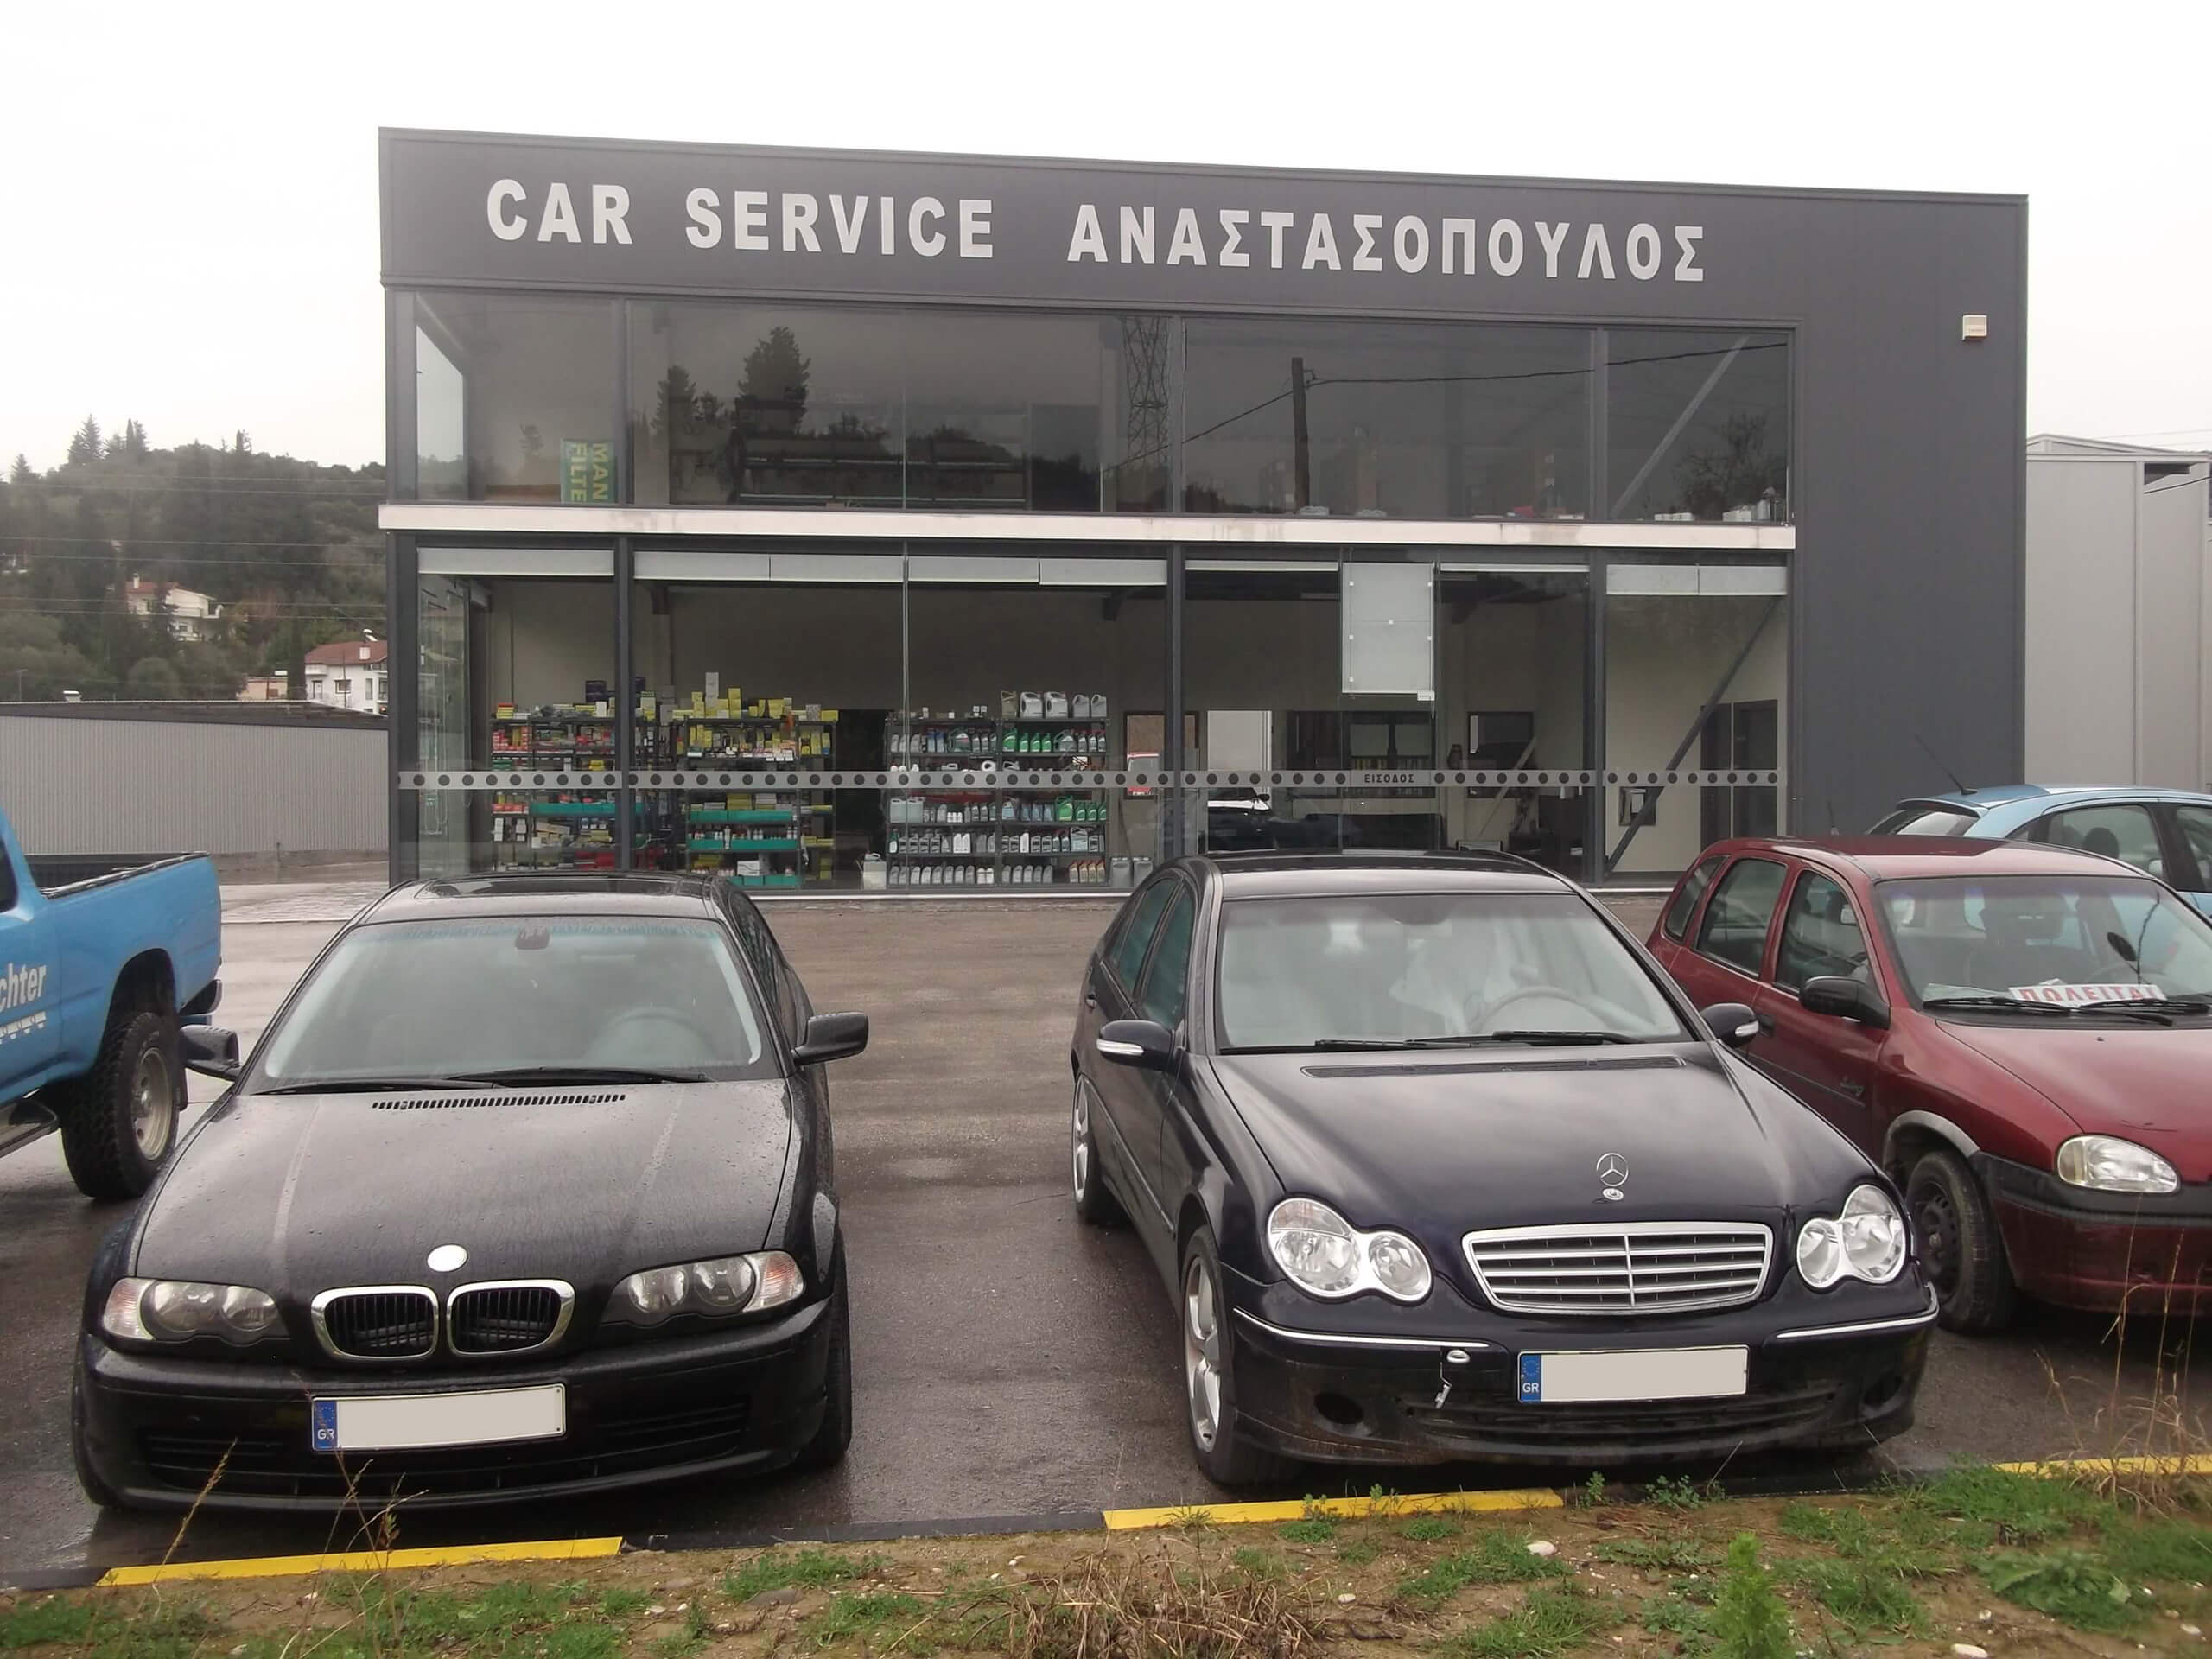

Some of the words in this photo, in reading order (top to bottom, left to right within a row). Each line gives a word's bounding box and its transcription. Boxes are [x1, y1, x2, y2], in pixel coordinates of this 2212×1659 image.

[487, 179, 632, 244] CAR
[686, 188, 992, 257] SERVICE
[1068, 205, 1702, 281] ΑΝΑΣΤΑΣΟΠΟΥΛΟΣ
[1364, 773, 1414, 783] ΕΙΣΟΔΟΣ
[2018, 986, 2158, 1002] ΠΩΛΕΙΤΑΙ
[1522, 1382, 1540, 1393] GR
[317, 1428, 335, 1440] GR
